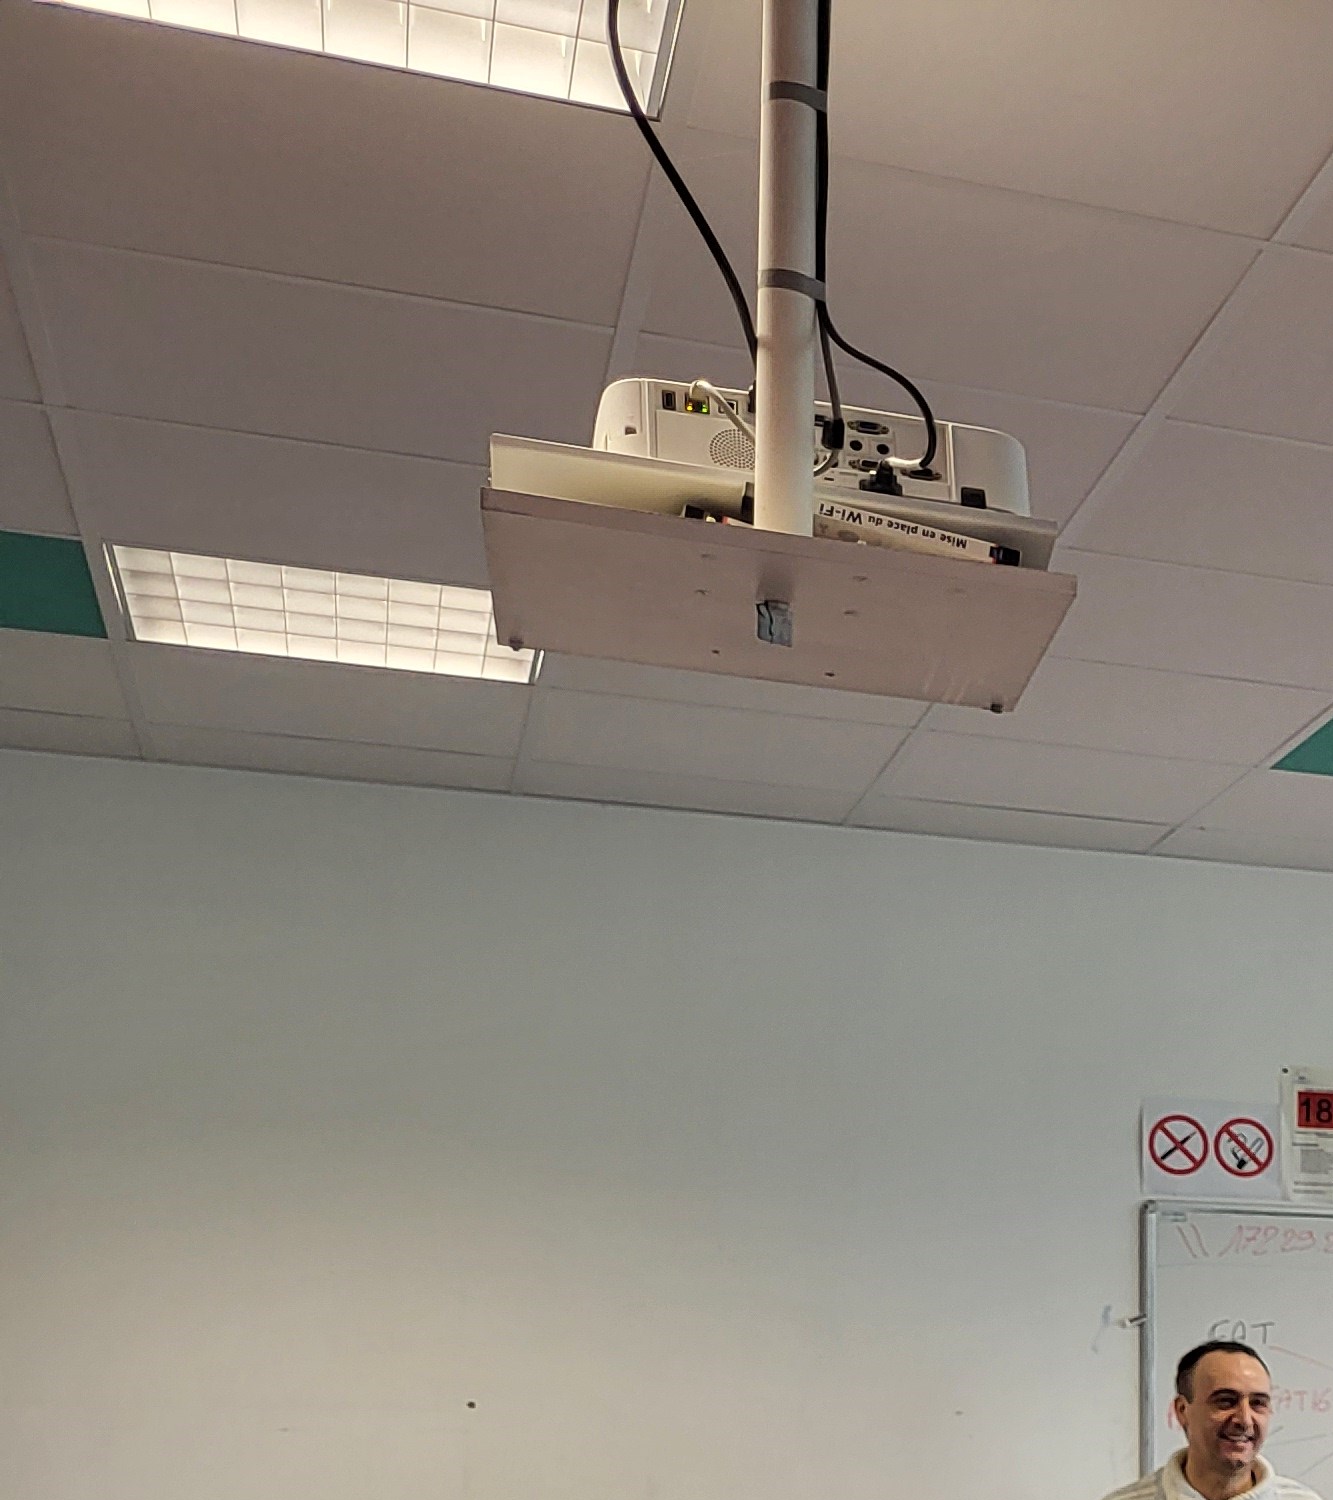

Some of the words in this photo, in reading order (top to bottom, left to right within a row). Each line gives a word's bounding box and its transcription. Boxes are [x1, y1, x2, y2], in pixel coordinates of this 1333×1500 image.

[819, 503, 862, 525] Wi-Fi
[868, 515, 883, 527] du
[887, 519, 919, 536] place
[922, 528, 936, 539] en
[939, 533, 967, 549] Mise
